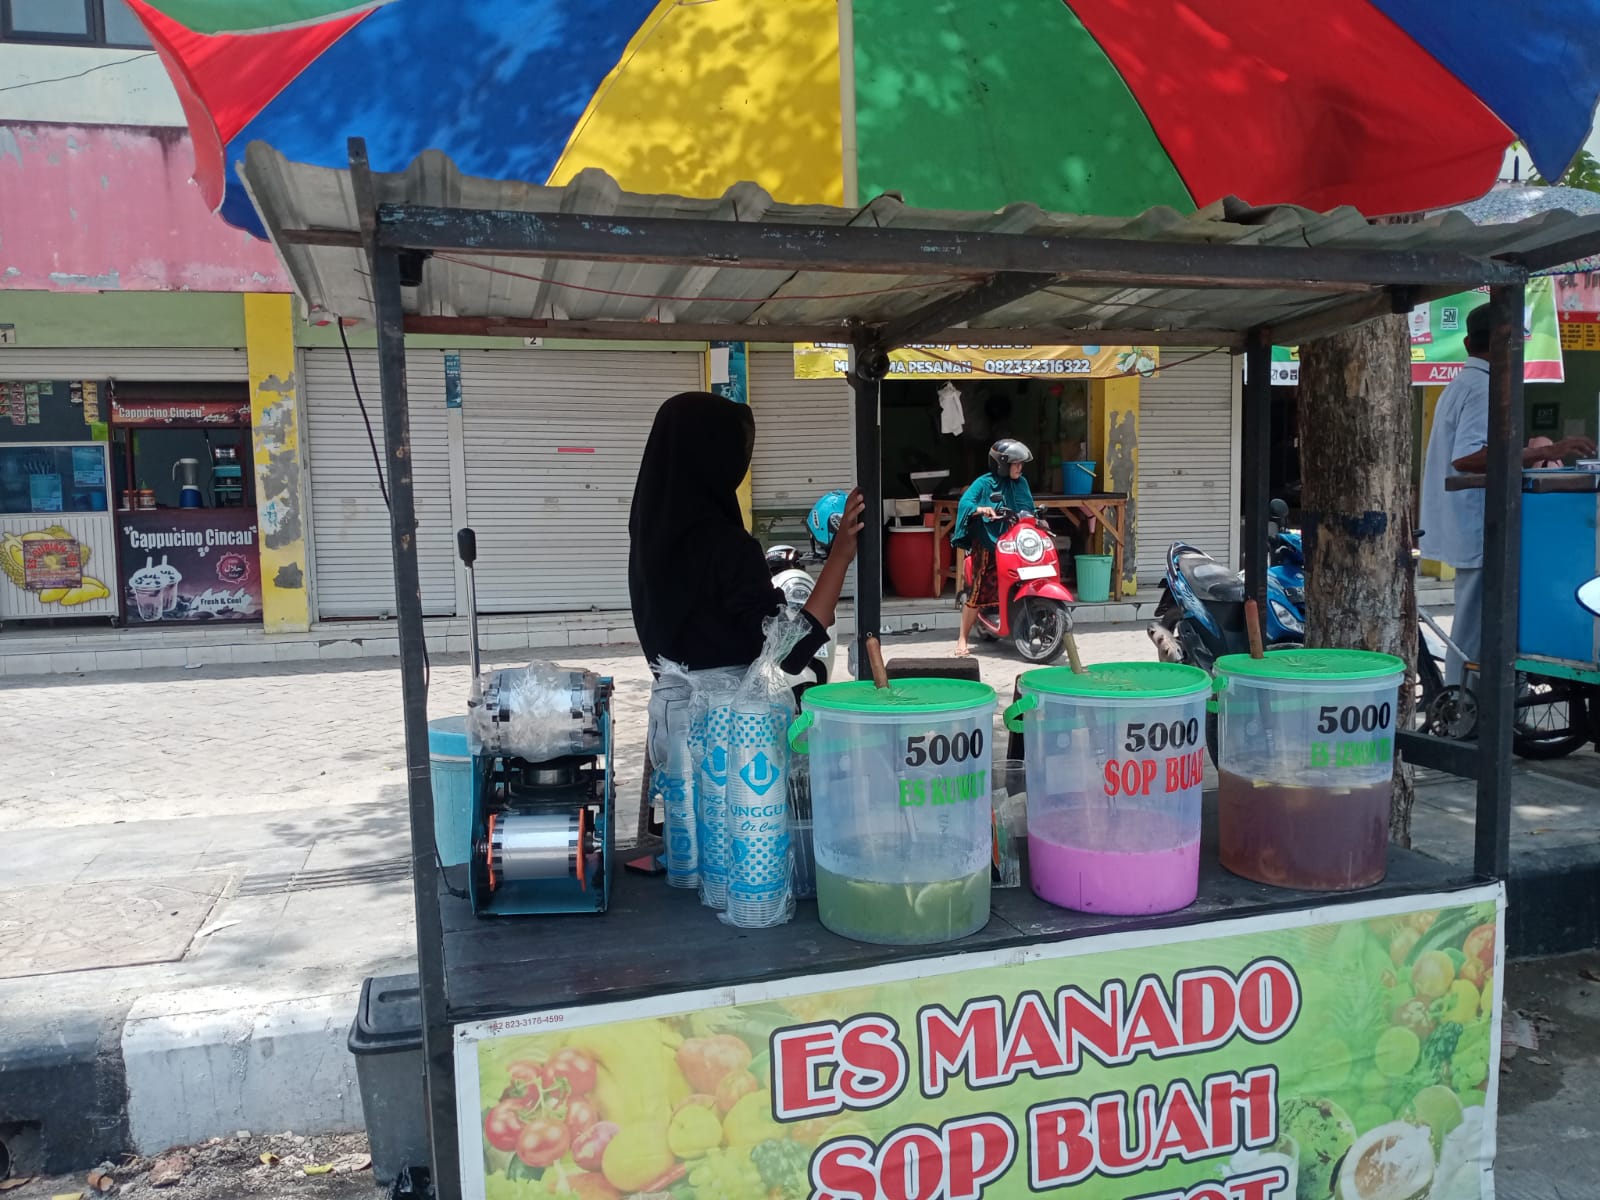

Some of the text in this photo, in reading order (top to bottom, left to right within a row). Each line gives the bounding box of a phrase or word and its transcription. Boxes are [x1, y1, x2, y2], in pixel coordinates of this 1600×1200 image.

[908, 359, 973, 373] PESANAN
[1428, 366, 1462, 380] AZM
[130, 528, 253, 549] Cappucino Cincau
[1124, 717, 1199, 752] 5000
[1317, 702, 1391, 734] 5000
[905, 728, 984, 767] 5000
[1311, 741, 1330, 767] ES
[898, 769, 986, 807] ES KUWUT
[1103, 759, 1158, 797] SOP
[769, 956, 1302, 1123] ES MANADO
[808, 1064, 1279, 1200] SOP BUAH
